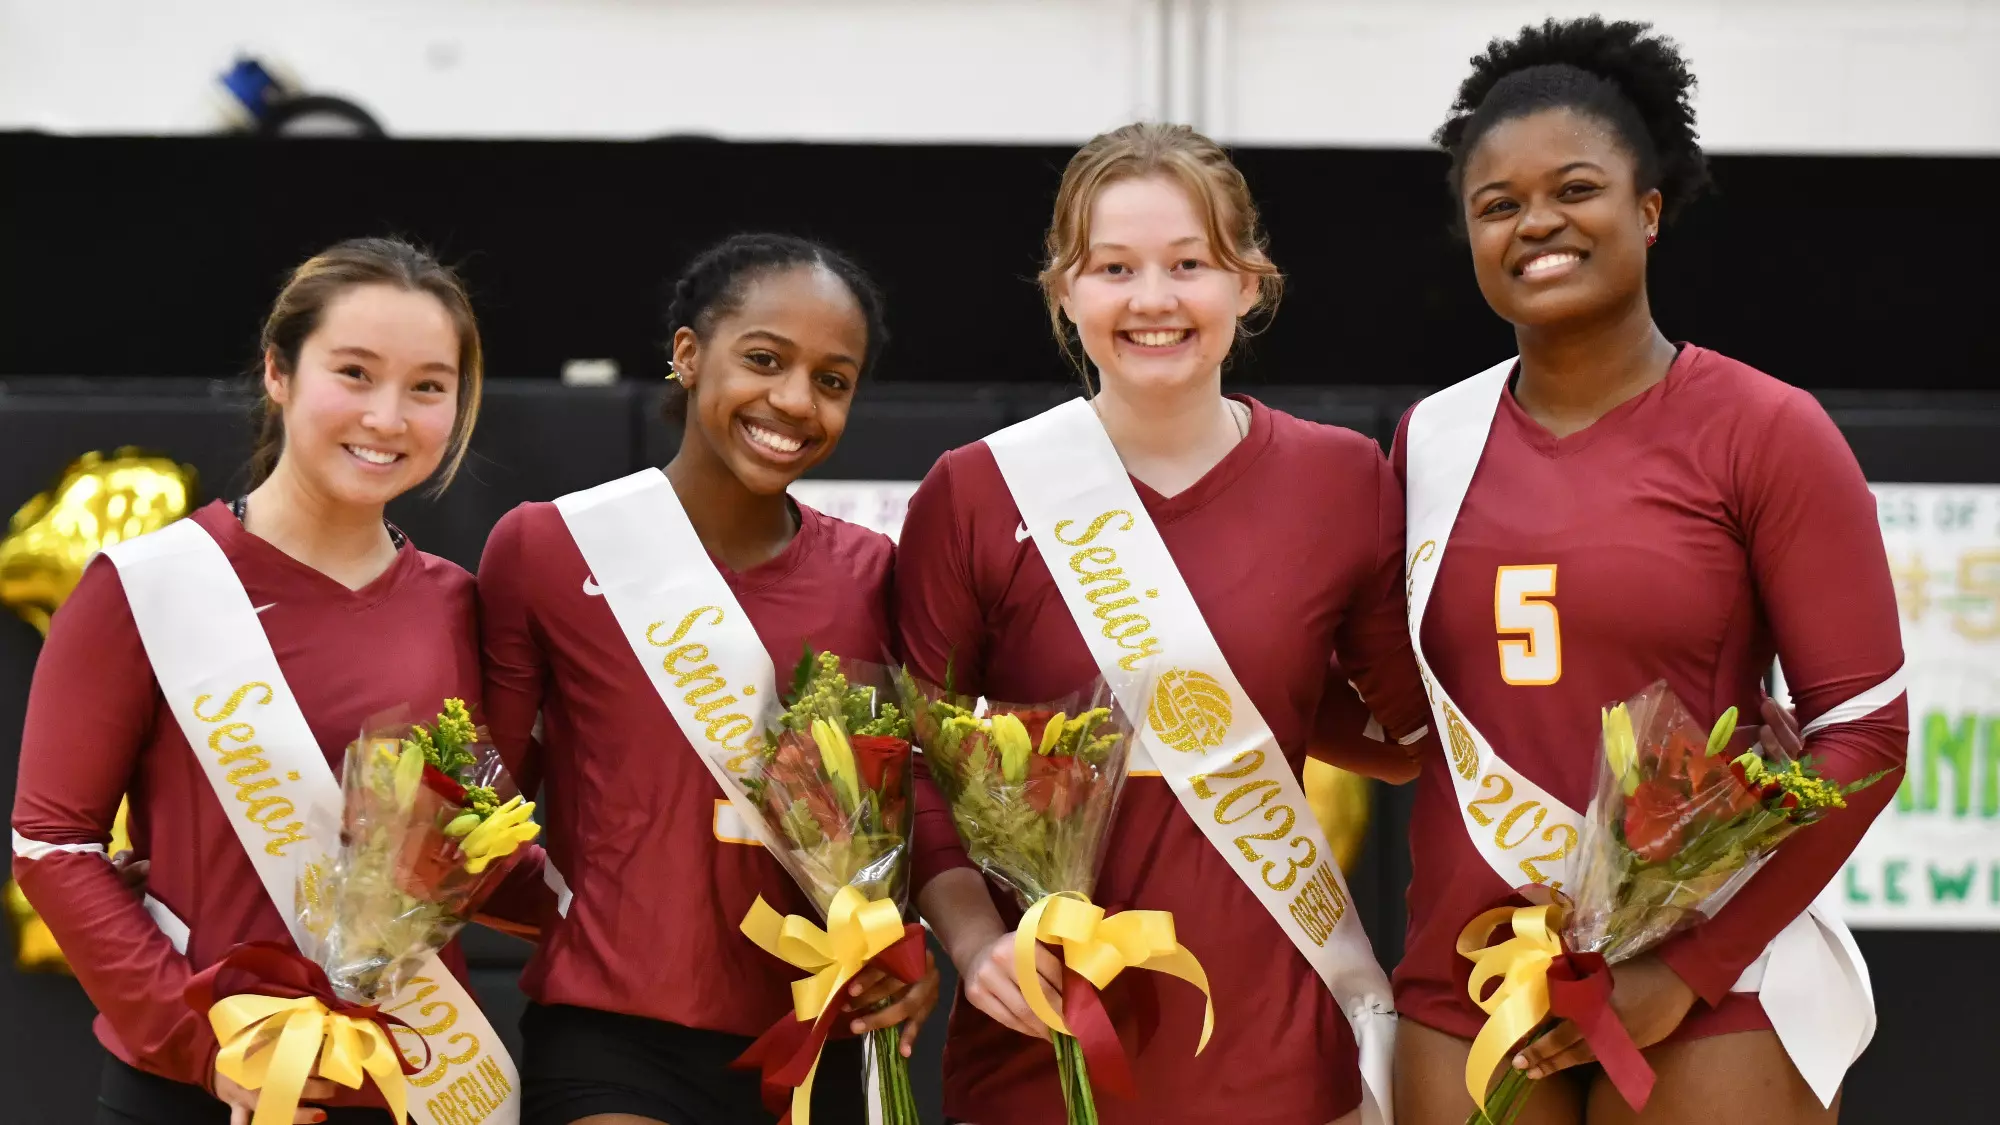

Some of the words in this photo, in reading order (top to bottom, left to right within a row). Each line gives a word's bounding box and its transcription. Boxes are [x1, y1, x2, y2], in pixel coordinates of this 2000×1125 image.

[1054, 509, 1164, 671] Senior
[1495, 564, 1562, 686] 5
[646, 605, 762, 773] Senior
[193, 681, 312, 857] Senior
[1188, 750, 1317, 892] 2023
[1288, 860, 1348, 947] OBERLIN
